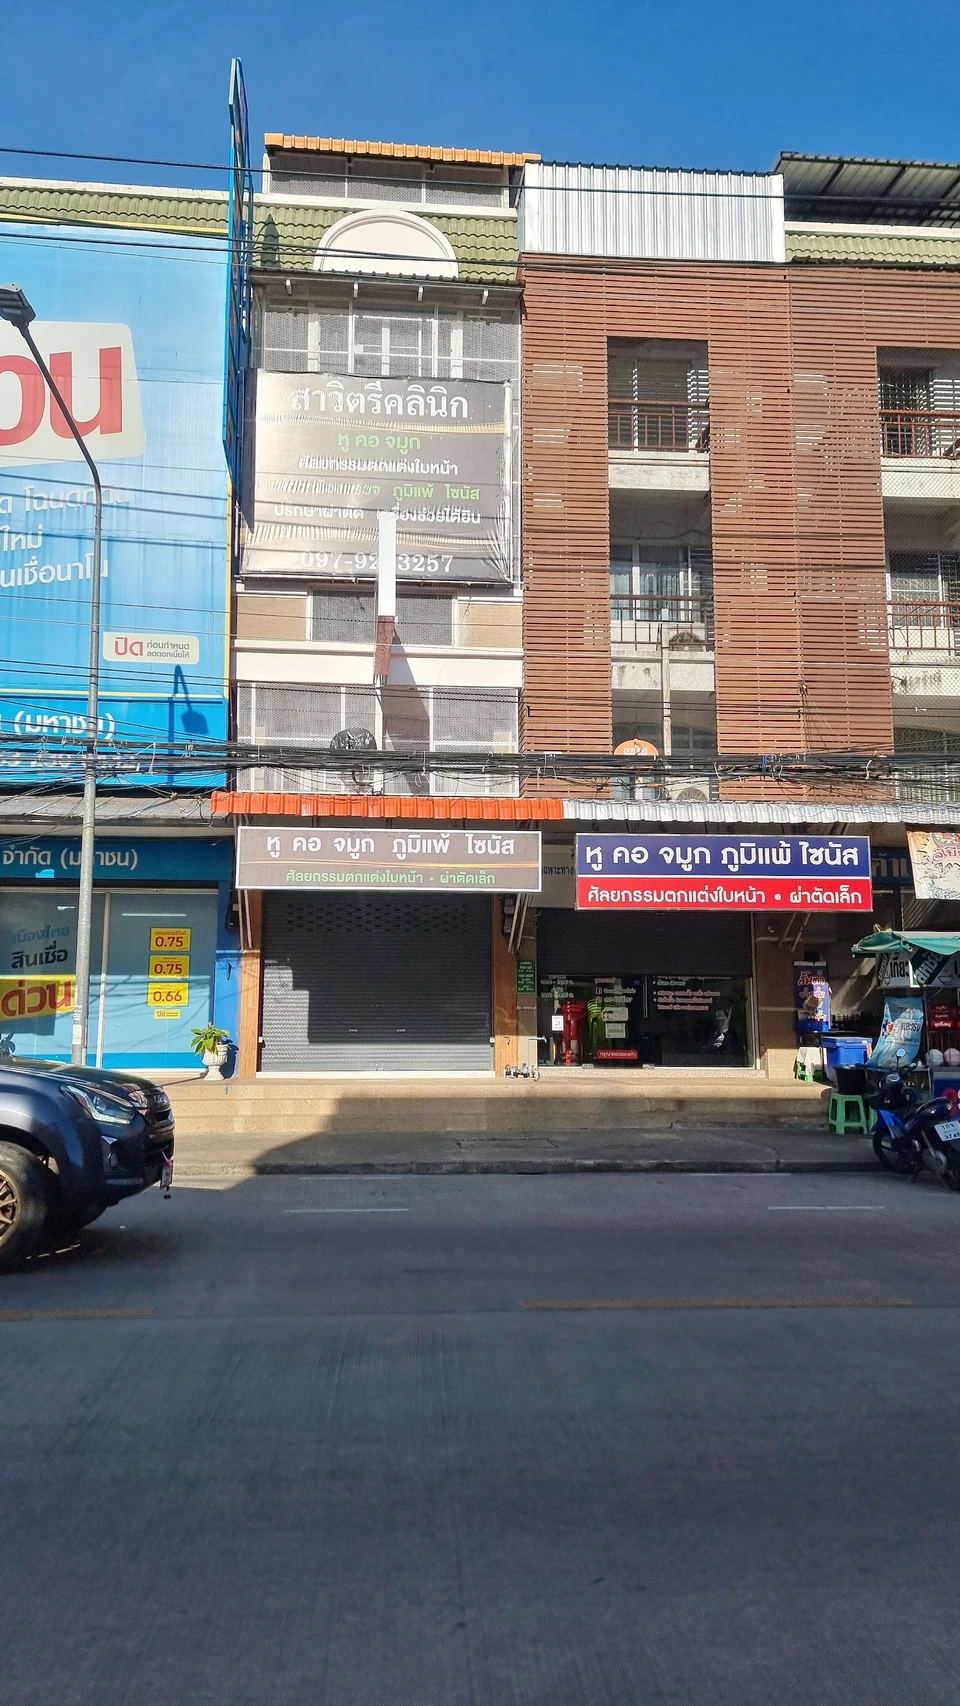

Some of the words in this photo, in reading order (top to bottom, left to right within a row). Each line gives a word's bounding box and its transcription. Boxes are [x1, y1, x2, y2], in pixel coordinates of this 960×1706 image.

[290, 381, 468, 418] สาวิตรีคลินิก
[338, 434, 350, 453] หู
[355, 435, 380, 448] คอ
[385, 436, 421, 454] จมูก
[299, 456, 458, 475] ศัลยกรรมตกแต่งใบหน้า
[393, 484, 434, 502] ภูมิแพ้
[444, 484, 480, 500] ไซนัส
[376, 502, 481, 524] เื่องช่วยได้ยิน
[300, 551, 454, 572] 097-923257
[115, 637, 143, 656] ปิด
[147, 641, 190, 650] ก่อนกำหนด
[267, 835, 280, 859] หู
[293, 836, 321, 852] คอ
[333, 836, 375, 859] จมูก
[392, 833, 450, 860] ภูมิแพ้
[465, 834, 515, 855] ไซนัส
[3, 845, 51, 865] จำกัด
[60, 848, 138, 870] (มาชน)
[586, 845, 602, 871] หู
[613, 846, 648, 864] คอ
[659, 845, 711, 871] จมูก
[721, 841, 791, 872] ภูมิแพ้
[799, 842, 859, 866] ไซนัส
[286, 869, 423, 883] ศัลยกรรมตกแต่งใบหน้า
[440, 870, 495, 884] ผ่าตัดเล็ก
[588, 886, 765, 903] ศัลยกรรมตกแต่งใบหน้า
[790, 885, 862, 904] ผ่าตัดเล็ก
[13, 925, 70, 943] เมืองไทย
[155, 936, 183, 948] 0.75
[12, 941, 68, 969] สินเชื่อ
[154, 963, 183, 975] 0.75
[1, 979, 72, 1017] ด่วน
[153, 990, 182, 1002] 0.66
